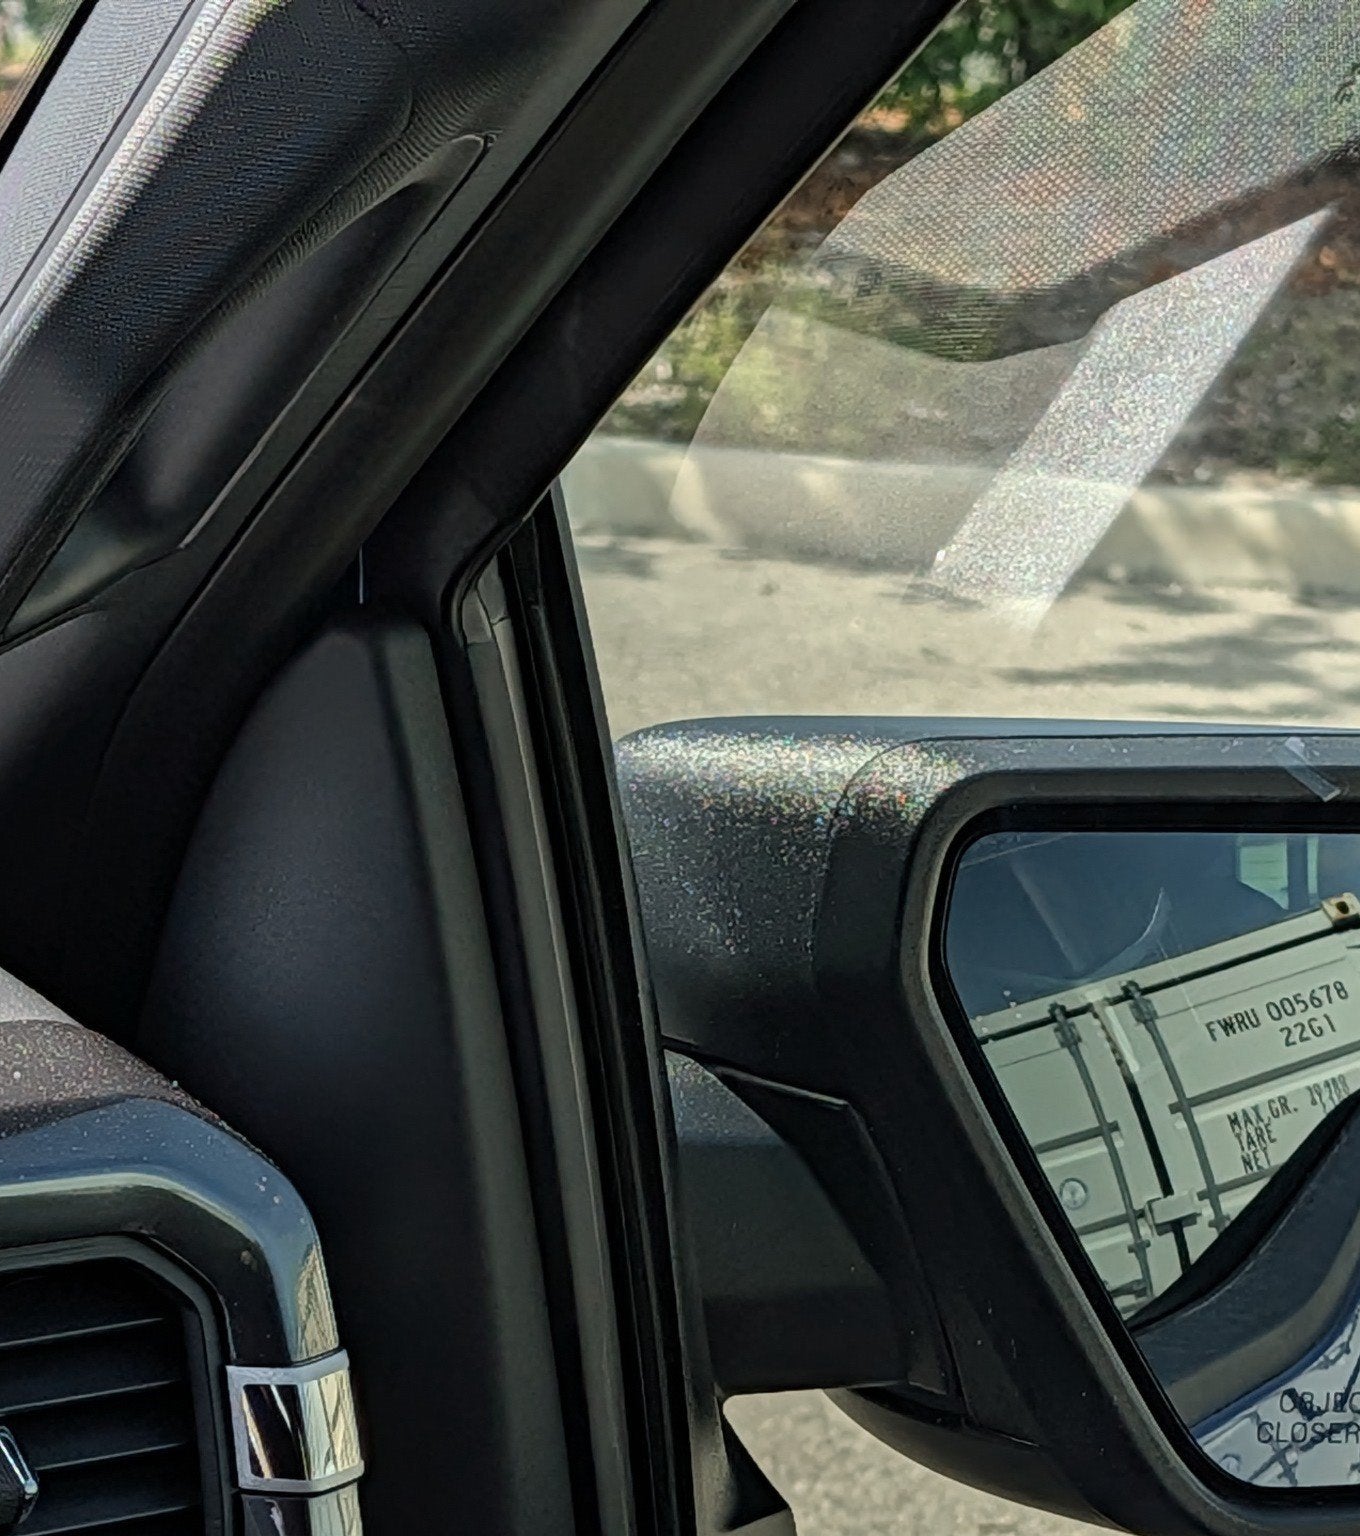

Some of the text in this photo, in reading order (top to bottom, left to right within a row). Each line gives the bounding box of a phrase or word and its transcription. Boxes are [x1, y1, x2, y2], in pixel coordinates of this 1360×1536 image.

[1205, 1008, 1261, 1042] FWRU
[1265, 980, 1349, 1021] 005678
[1279, 1013, 1336, 1047] 22G1
[1235, 1119, 1278, 1152] TARE
[1241, 1146, 1271, 1174] NET
[1257, 1422, 1360, 1444] CLOSER
